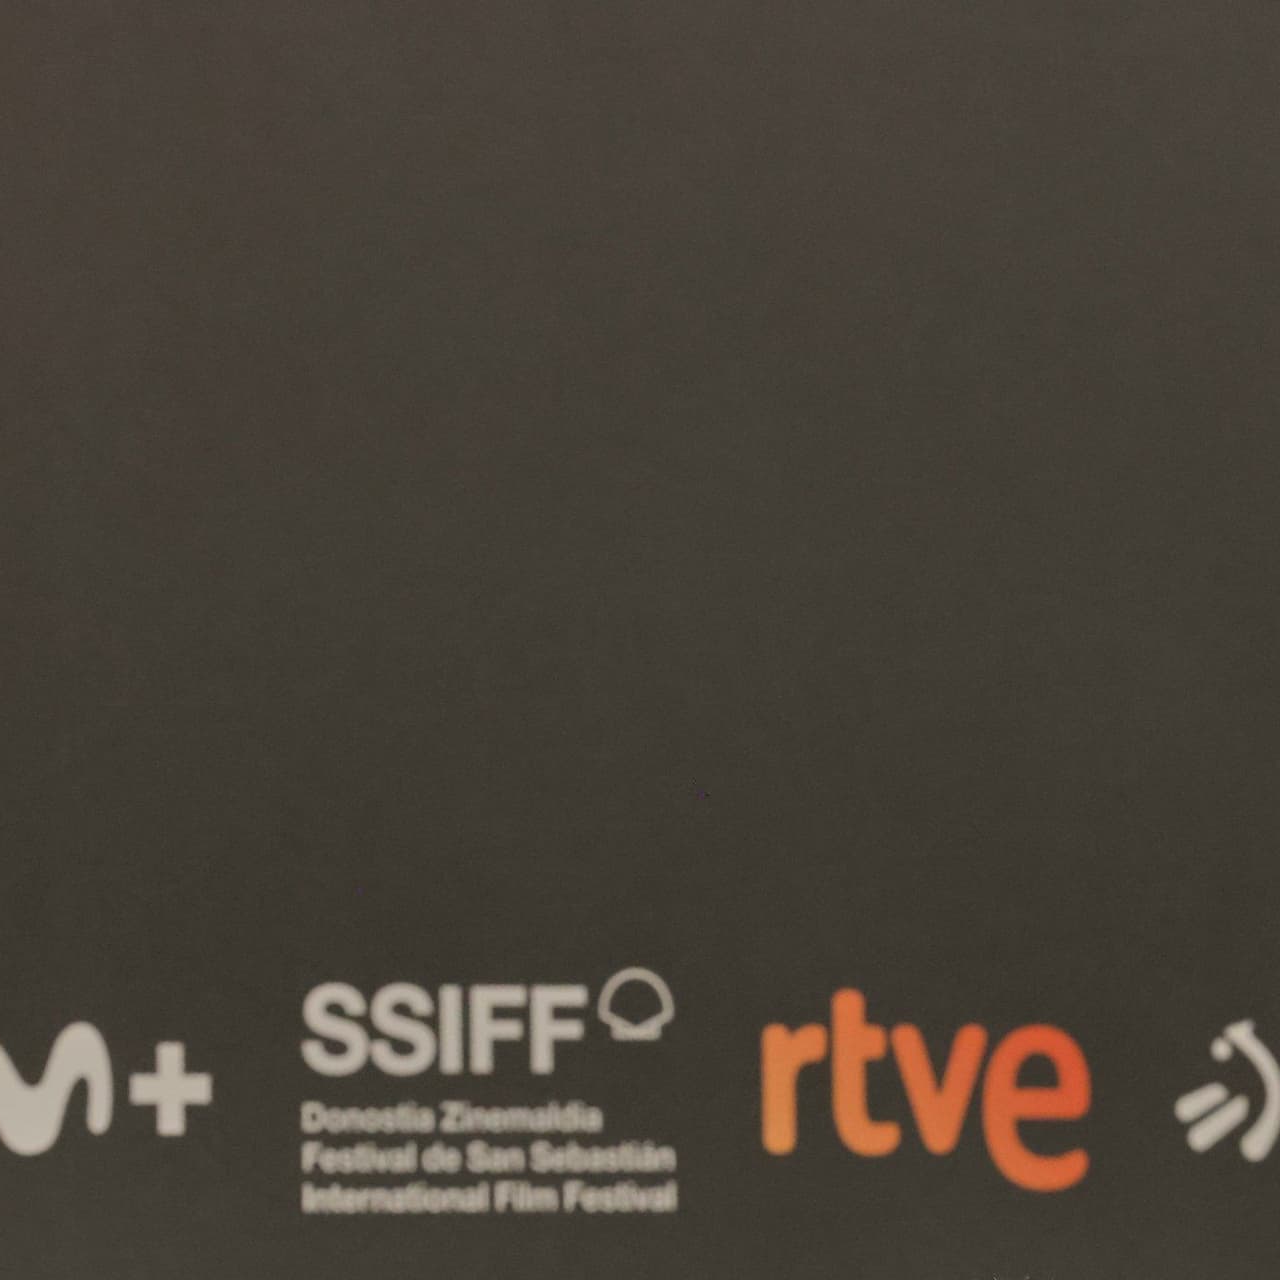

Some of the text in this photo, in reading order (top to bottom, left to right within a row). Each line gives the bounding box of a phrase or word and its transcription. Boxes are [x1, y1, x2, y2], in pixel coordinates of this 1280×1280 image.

[301, 982, 588, 1076] SSIFF
[761, 988, 1091, 1191] rtve
[301, 1100, 604, 1134] Donostia Zinemaldia
[301, 1140, 418, 1174] Festival
[421, 1140, 462, 1174] de
[466, 1139, 526, 1173] San
[301, 1179, 678, 1214] International Film Festival
